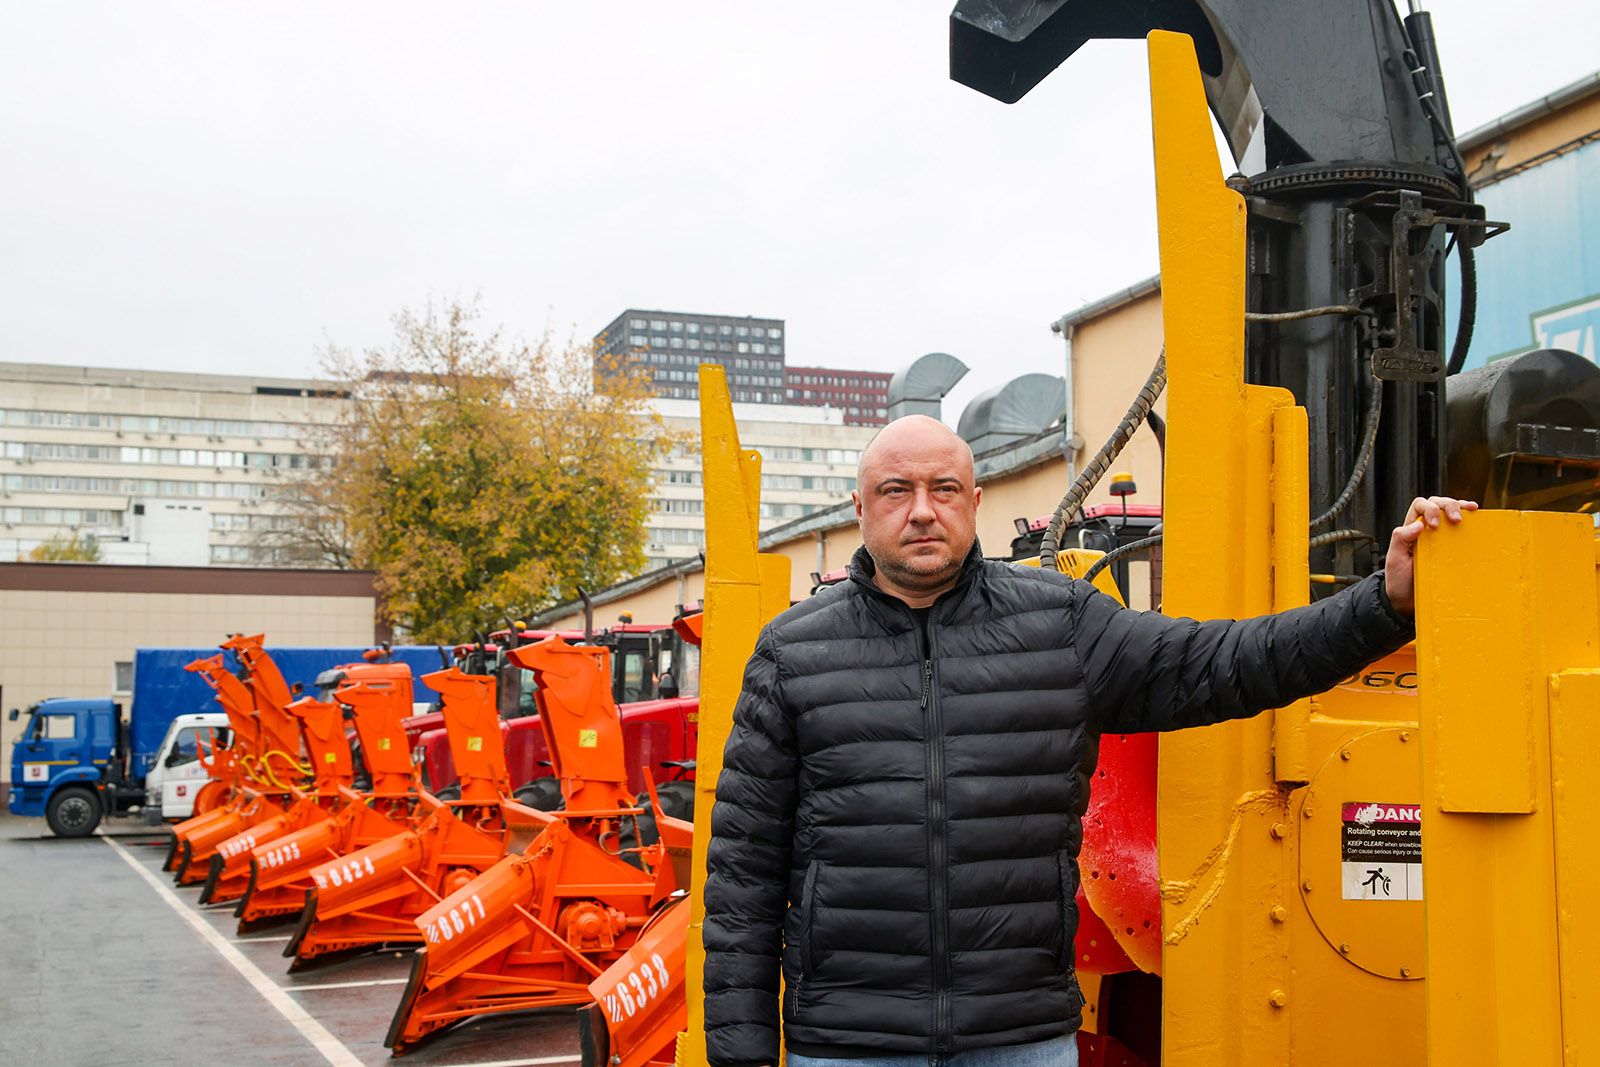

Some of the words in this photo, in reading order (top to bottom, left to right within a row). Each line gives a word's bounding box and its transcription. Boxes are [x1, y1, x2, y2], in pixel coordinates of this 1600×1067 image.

[1347, 827, 1376, 836] Rotating
[1377, 829, 1408, 838] conveyor
[328, 856, 375, 887] 6424
[438, 895, 486, 941] 6671
[616, 954, 669, 1017] 6338
